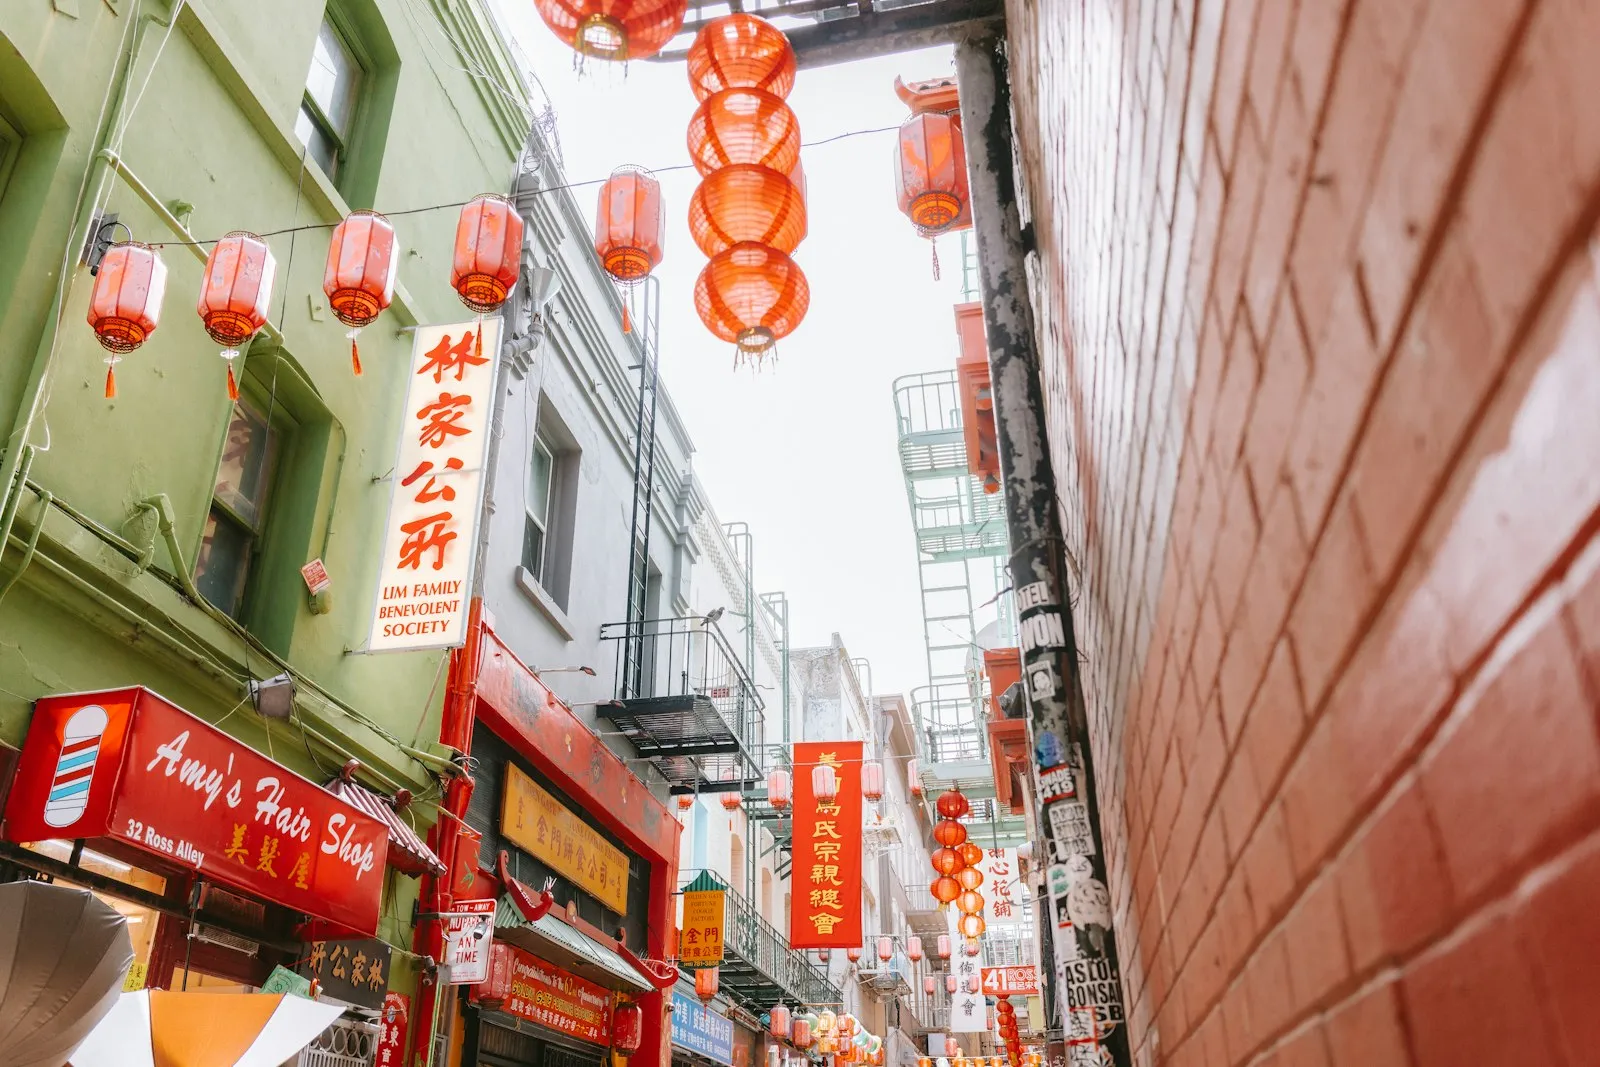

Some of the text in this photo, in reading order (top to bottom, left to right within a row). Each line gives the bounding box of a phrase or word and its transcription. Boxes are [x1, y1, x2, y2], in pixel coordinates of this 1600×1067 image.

[396, 330, 491, 571] 林家公所
[383, 580, 462, 600] LIM FAMILY
[379, 599, 460, 619] BENEVOLENT
[383, 619, 450, 637] SOCIETY
[146, 730, 375, 881] Amy's Hair Shop
[125, 818, 206, 869] 32 Ross Alley
[457, 936, 478, 949] ANY
[685, 927, 719, 944] 金門
[455, 951, 479, 964] TIME
[984, 968, 1007, 991] 41
